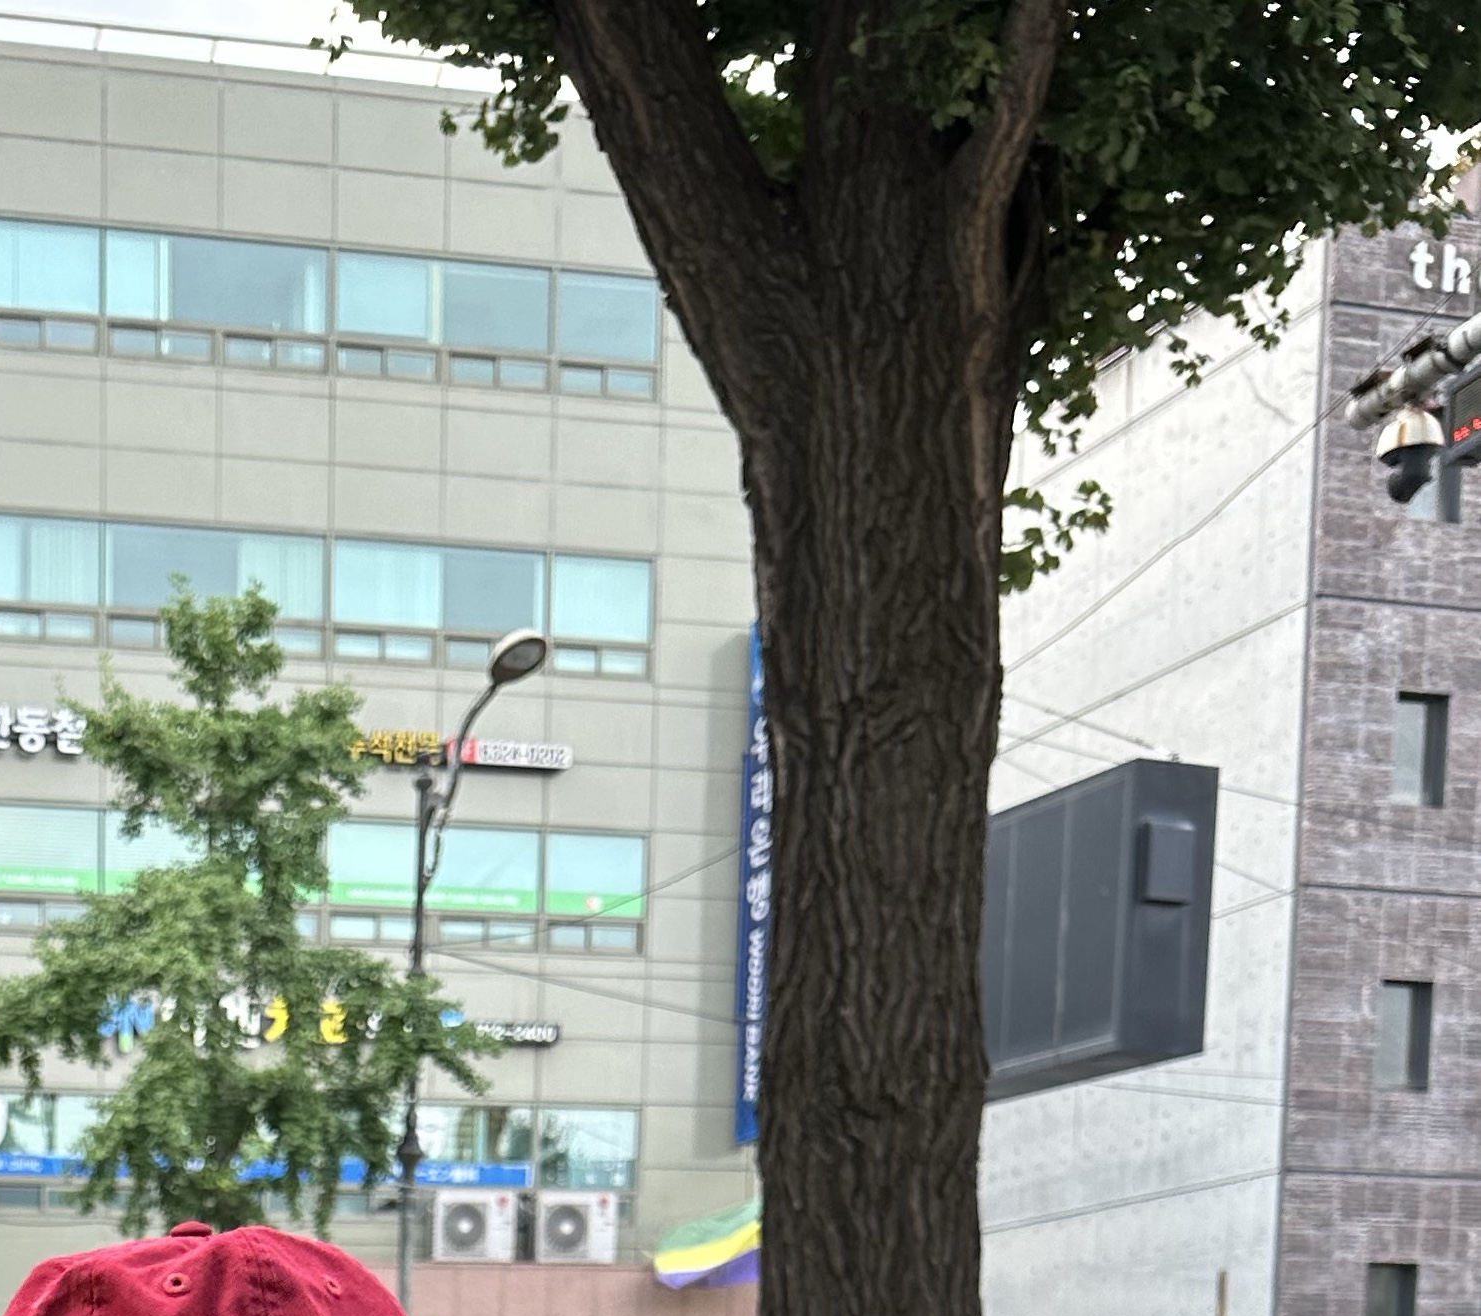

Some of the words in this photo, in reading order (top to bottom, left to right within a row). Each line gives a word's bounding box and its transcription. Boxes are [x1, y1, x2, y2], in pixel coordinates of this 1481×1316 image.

[1409, 241, 1481, 294] th
[745, 927, 766, 1021] WOORI
[742, 1024, 761, 1101] BANK
